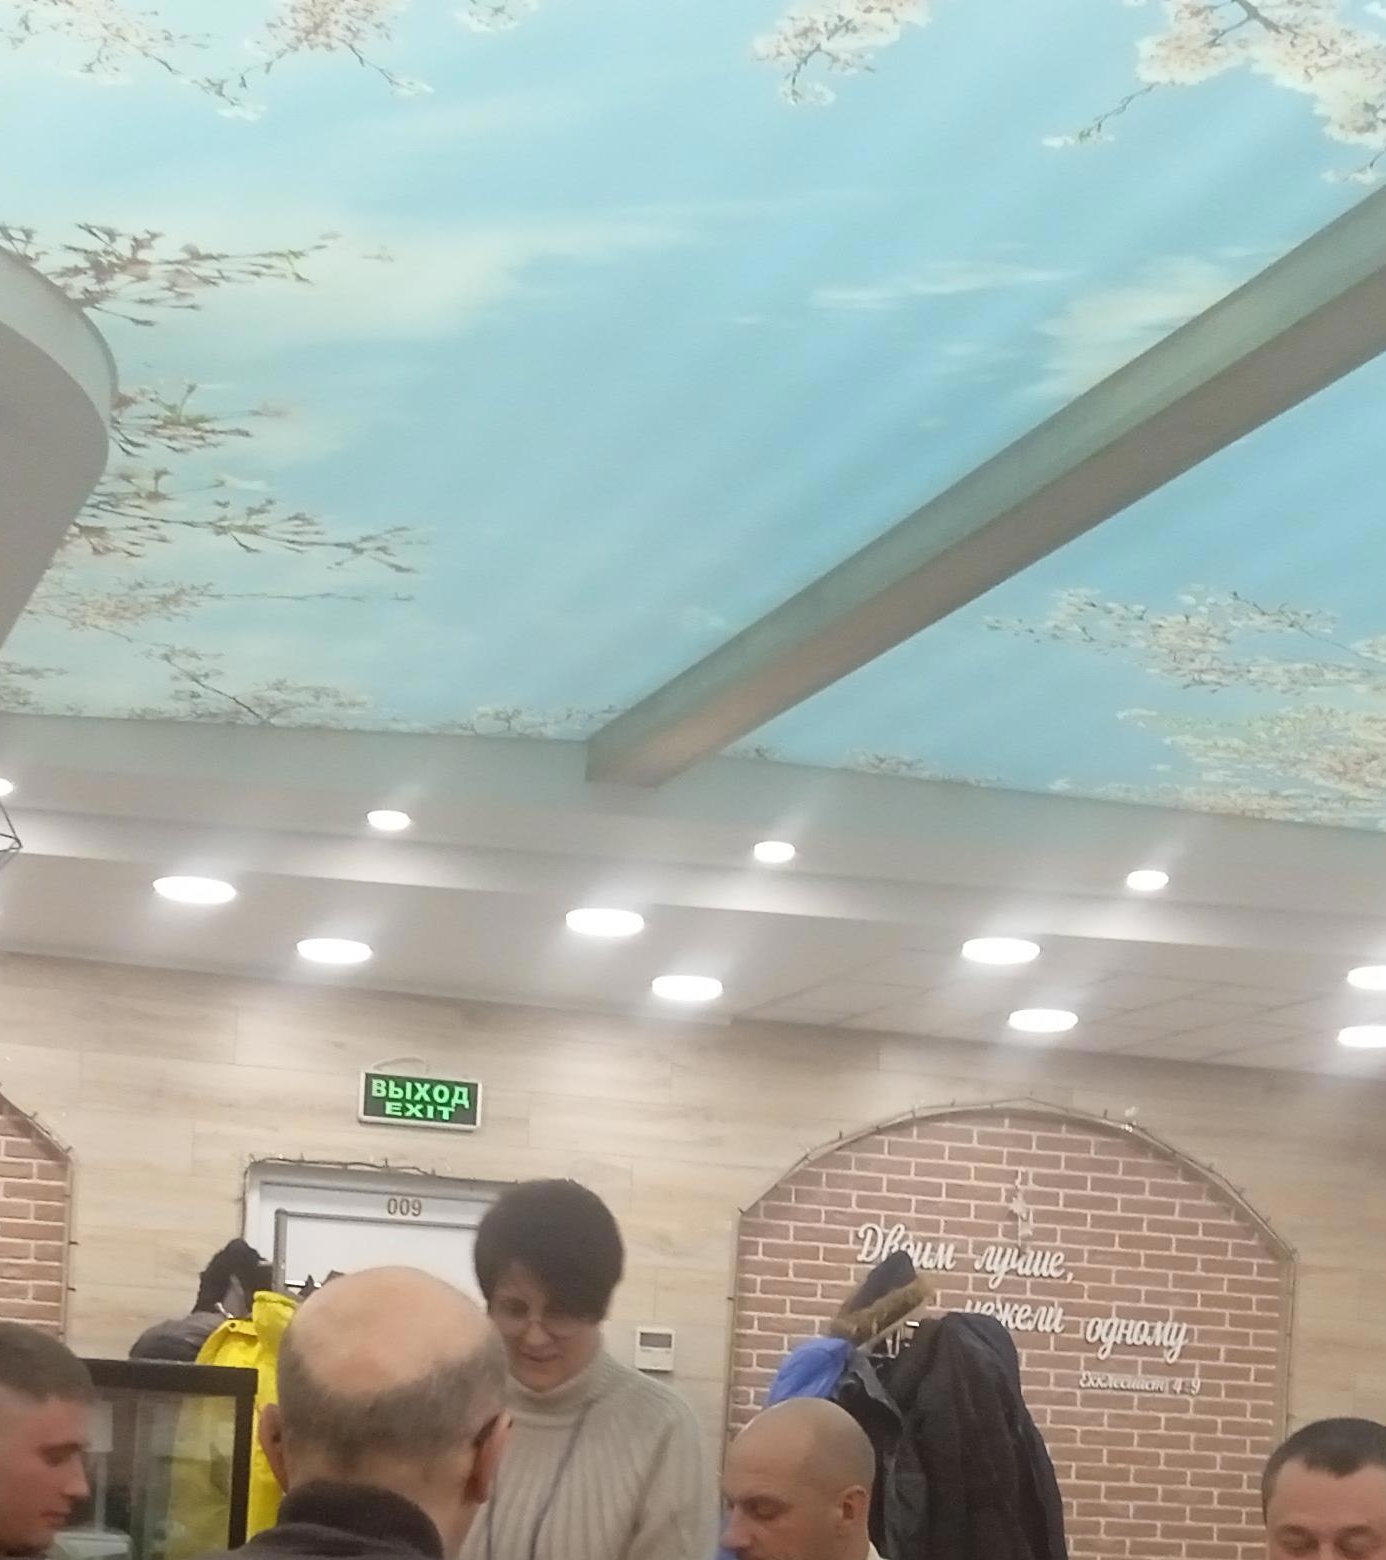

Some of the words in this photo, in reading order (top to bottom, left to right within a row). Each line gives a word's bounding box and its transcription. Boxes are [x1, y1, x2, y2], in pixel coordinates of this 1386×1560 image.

[371, 1078, 470, 1109] ВЫХОД
[384, 1101, 455, 1120] EXIT
[387, 1198, 422, 1216] 009
[1085, 1317, 1189, 1363] одному
